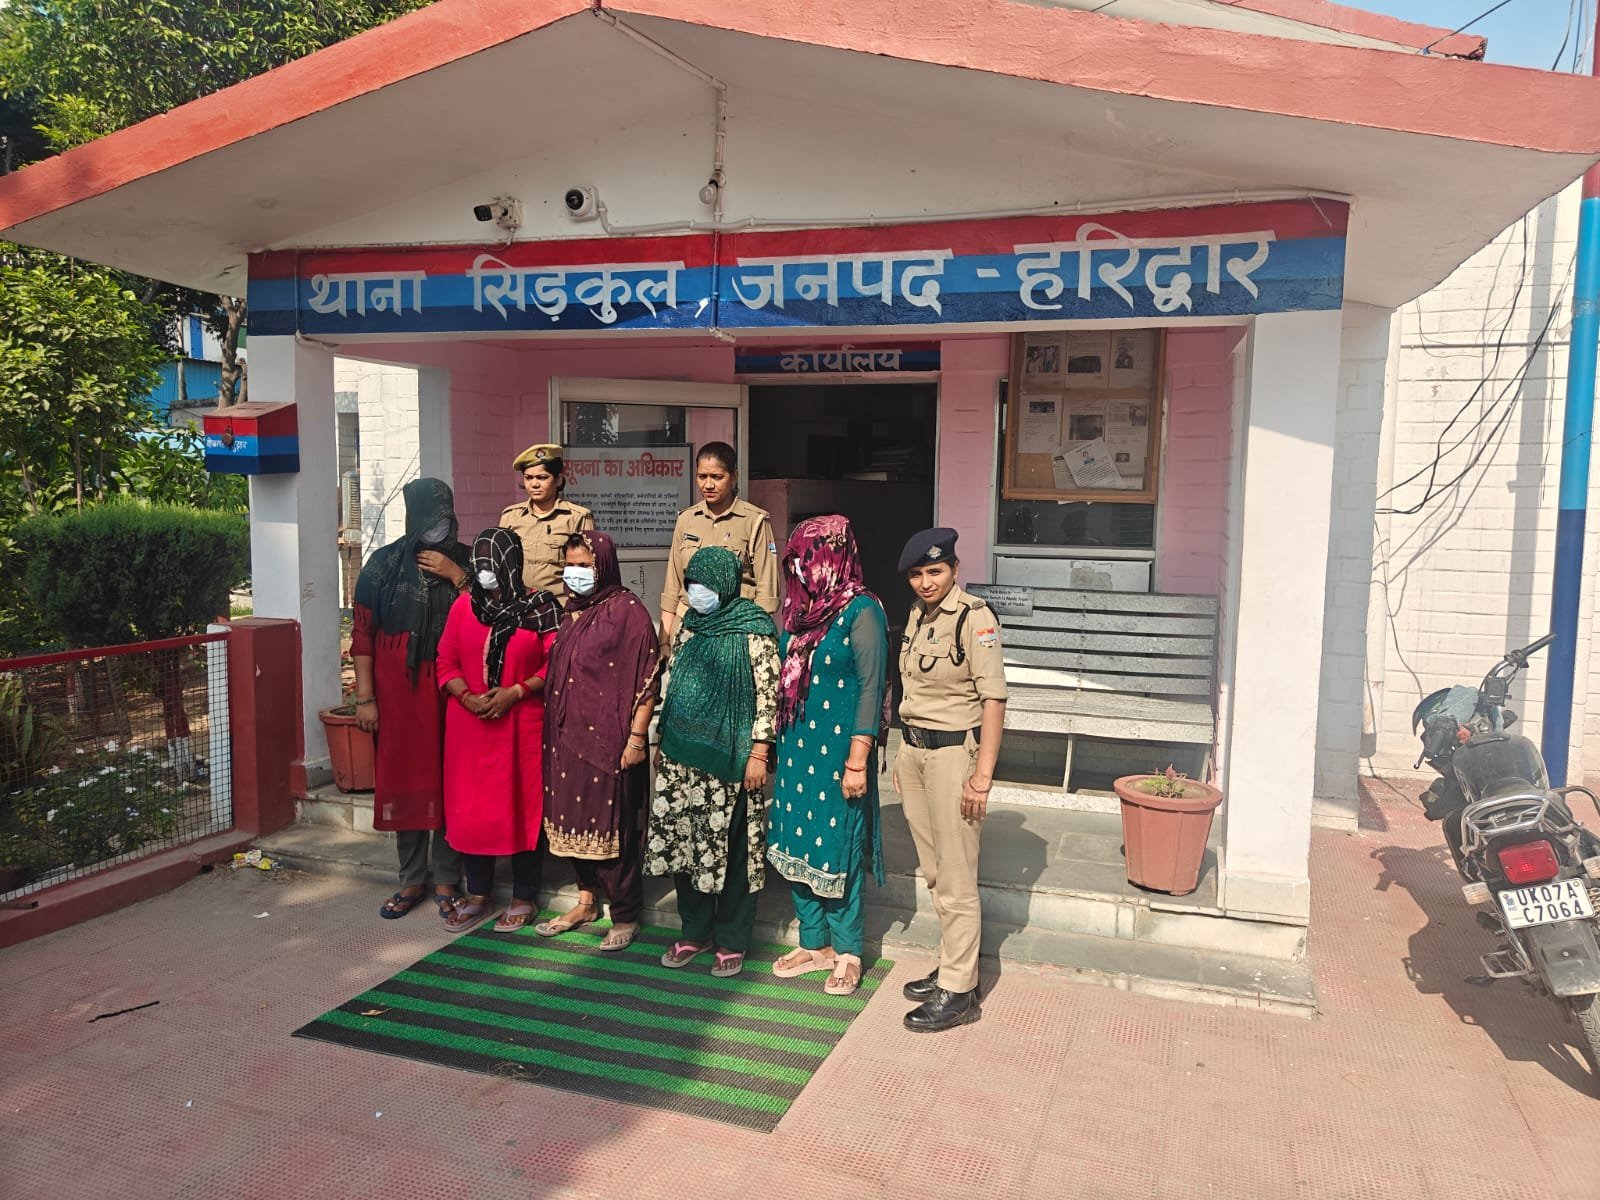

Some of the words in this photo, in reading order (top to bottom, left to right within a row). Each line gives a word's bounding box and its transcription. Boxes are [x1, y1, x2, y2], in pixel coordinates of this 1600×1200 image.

[308, 270, 428, 318] थाना
[465, 254, 686, 324] सिड़कुल
[731, 248, 954, 317] जनपद
[1013, 222, 1277, 312] हरिद्वार
[780, 343, 903, 373] कार्यालय
[562, 459, 601, 485] सूचना
[603, 459, 624, 477] का
[626, 451, 685, 477] अधिकार
[1523, 899, 1585, 923] C7064
